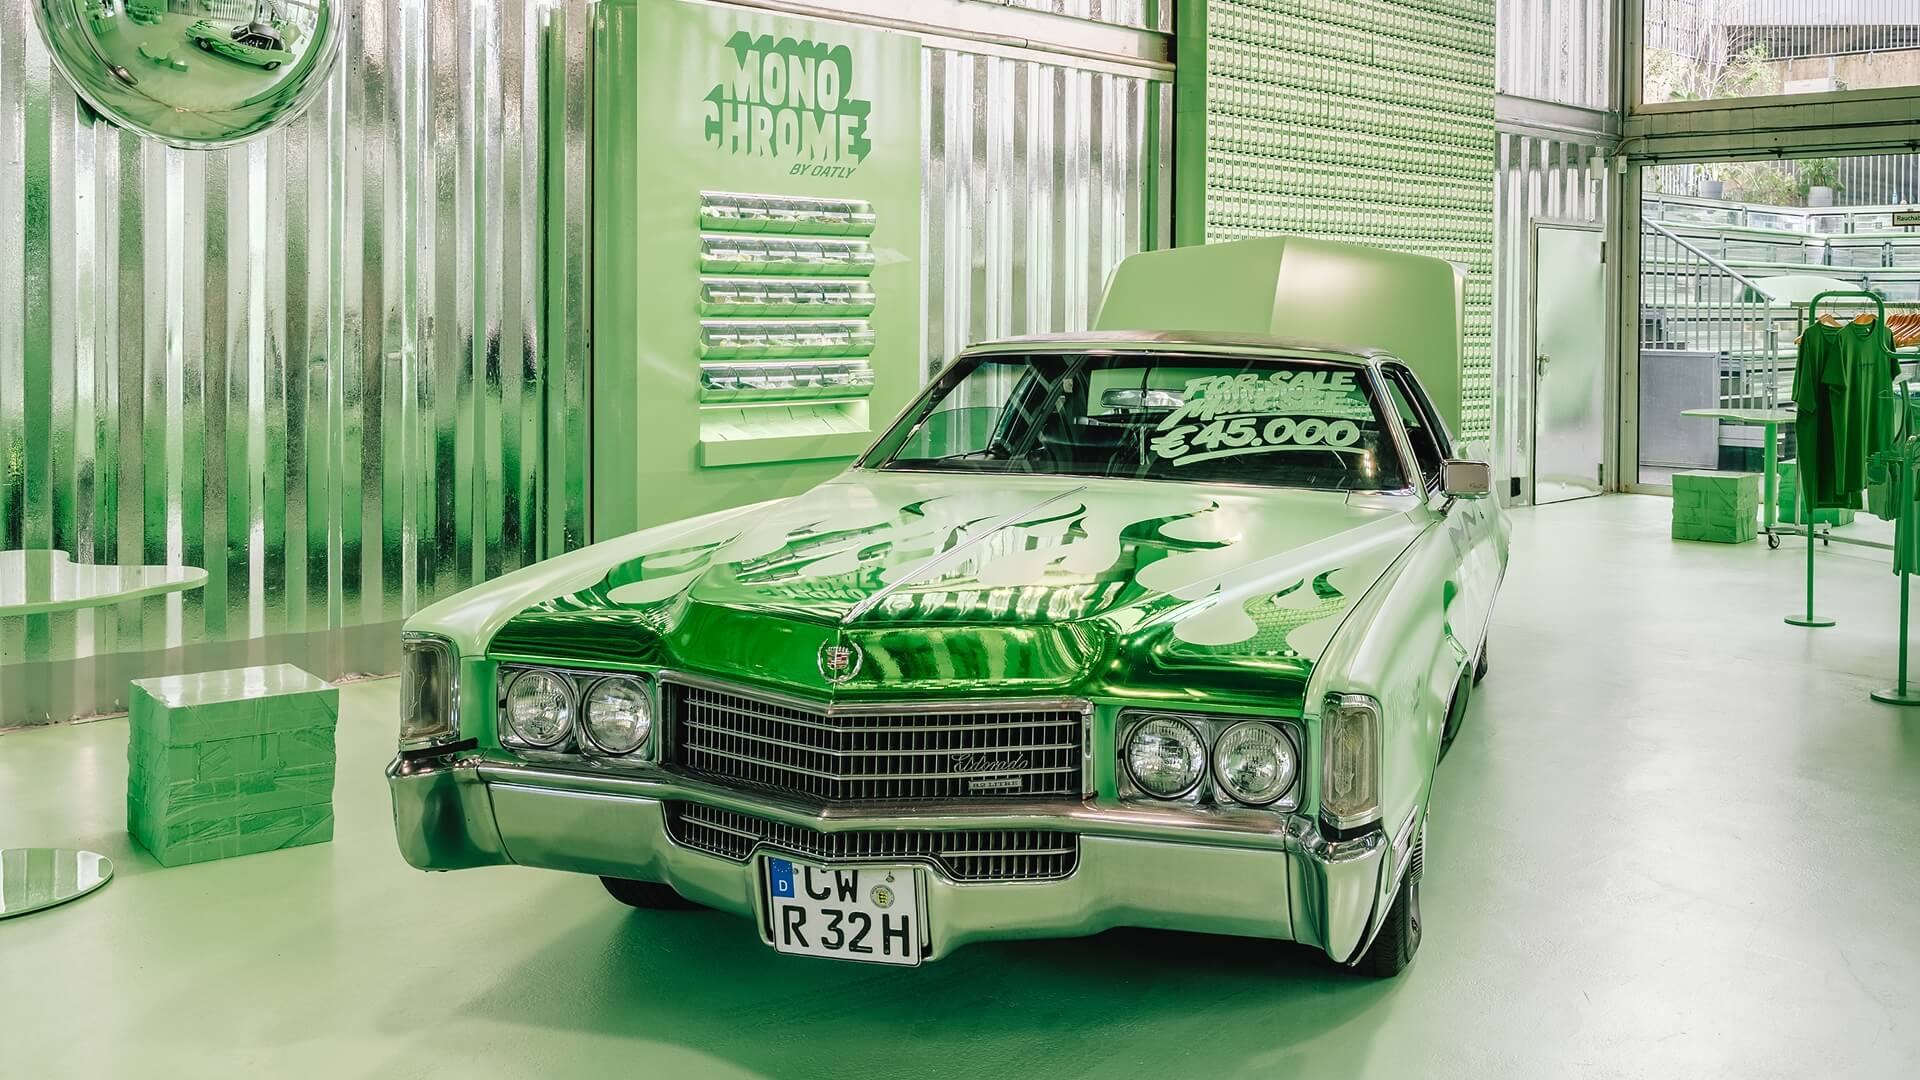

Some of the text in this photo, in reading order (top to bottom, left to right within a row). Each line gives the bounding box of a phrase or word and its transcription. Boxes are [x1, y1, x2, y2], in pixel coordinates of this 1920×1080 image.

[721, 44, 842, 112] MONO
[704, 99, 863, 163] CHROME
[789, 163, 856, 179] BY OATLY
[1183, 371, 1356, 400] FOR SALE
[1149, 417, 1361, 459] €45.000
[951, 753, 1029, 774] Eldorado
[778, 879, 788, 892] D
[804, 865, 859, 903] CW
